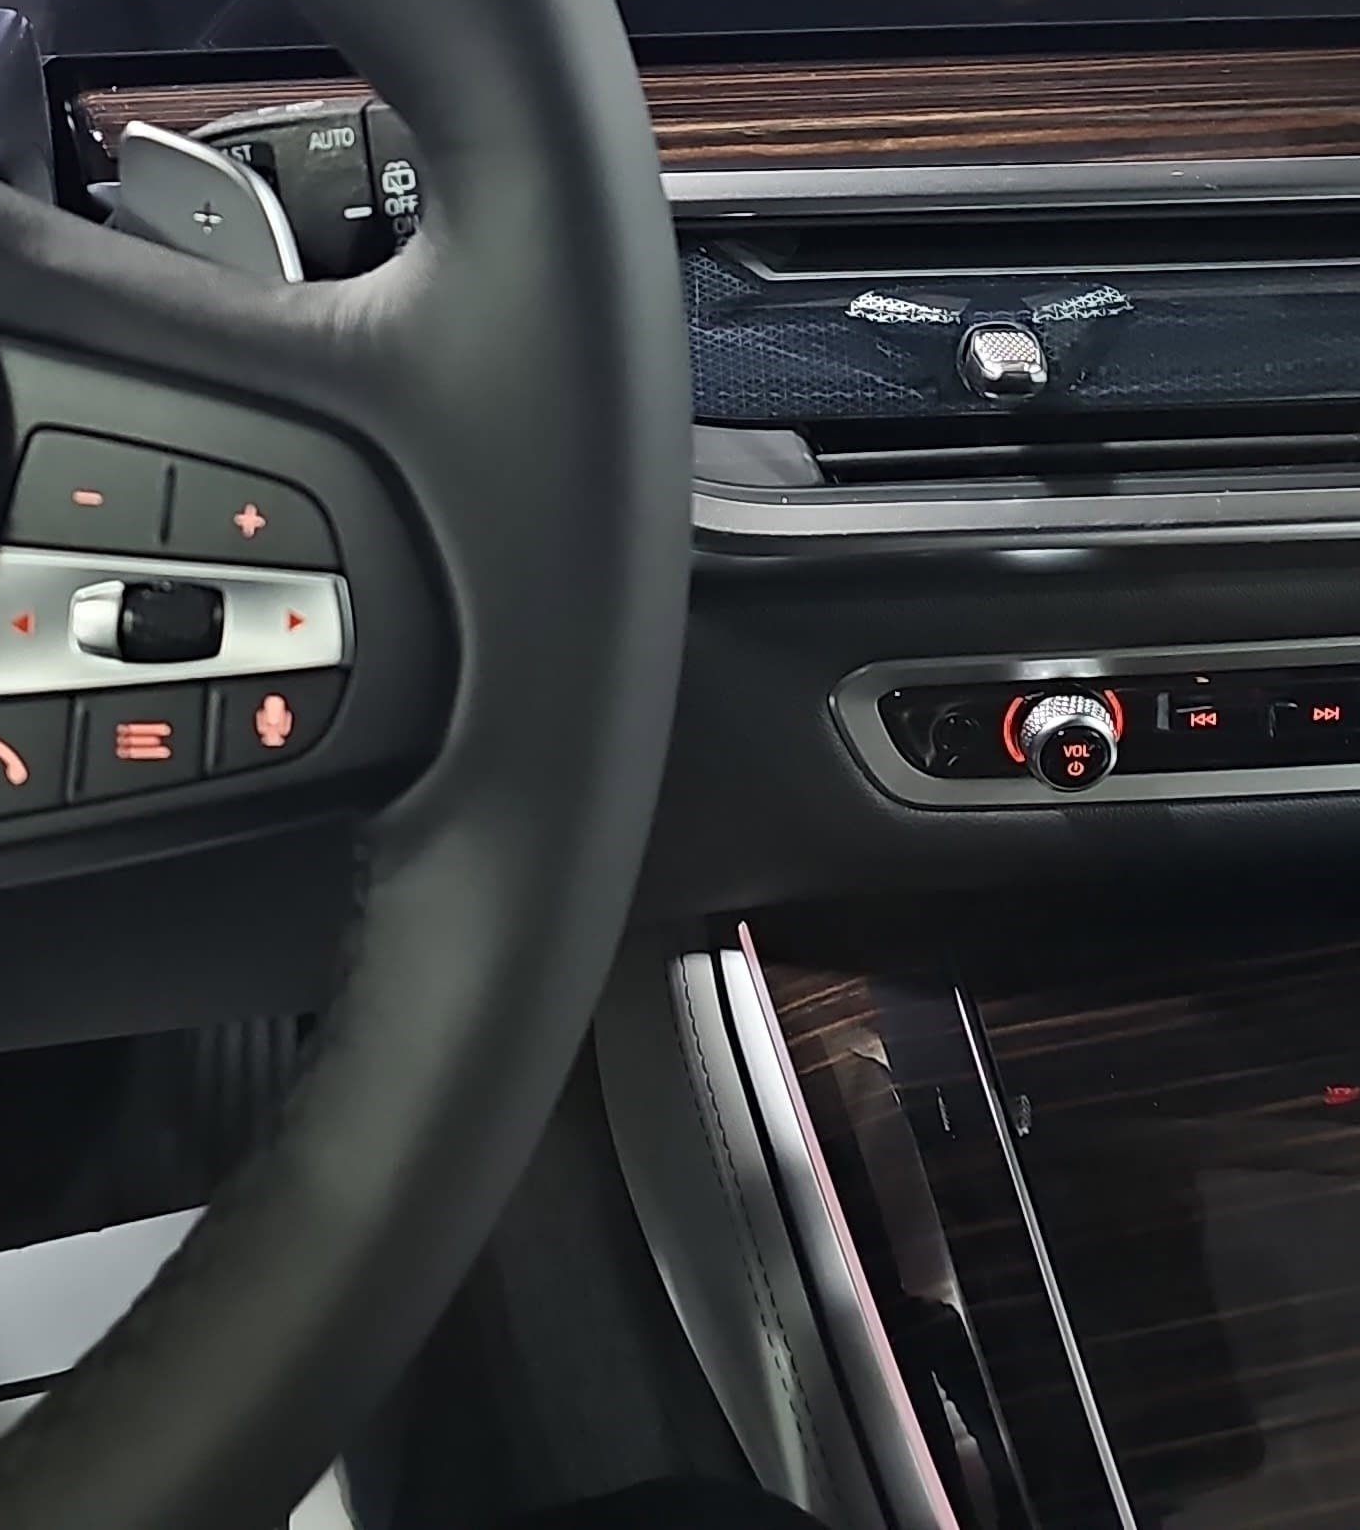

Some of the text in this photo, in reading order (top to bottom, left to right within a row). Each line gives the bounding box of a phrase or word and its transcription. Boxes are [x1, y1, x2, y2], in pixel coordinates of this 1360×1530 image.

[309, 127, 355, 151] AUTO
[384, 194, 418, 216] OFF
[1063, 744, 1090, 758] VOL
